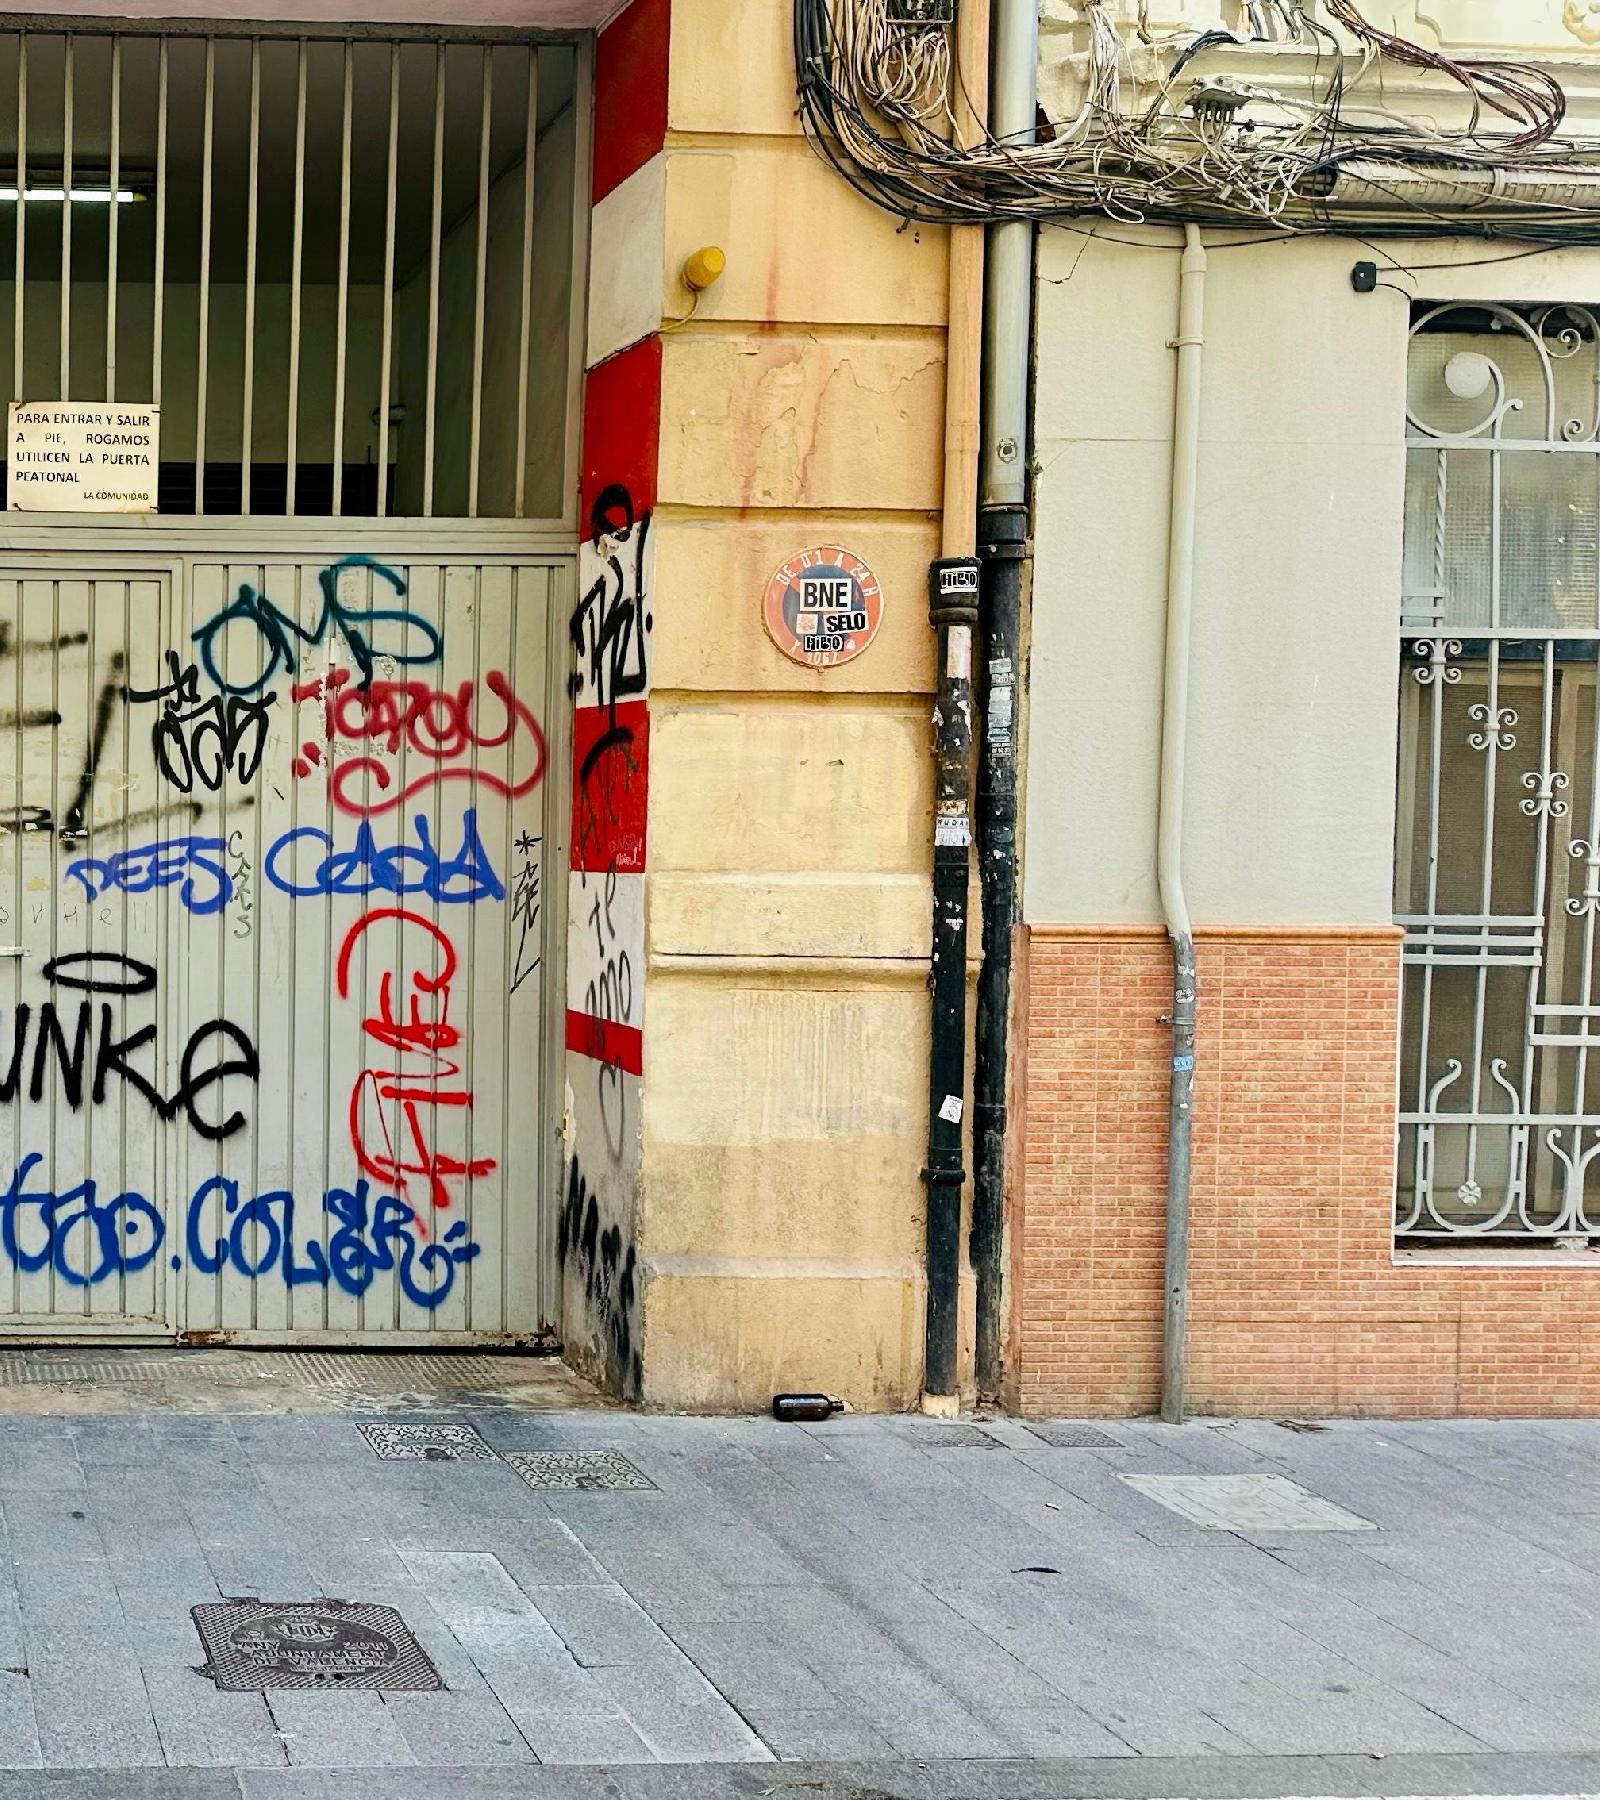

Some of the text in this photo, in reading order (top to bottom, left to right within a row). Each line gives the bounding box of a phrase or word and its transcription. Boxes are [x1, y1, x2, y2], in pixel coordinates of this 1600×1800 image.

[16, 413, 150, 426] PARA ENTRAR Y SALIR
[16, 432, 150, 446] A PIE, ROGAMOS
[16, 451, 150, 466] UTILICEN LA PUERTA
[16, 471, 80, 483] PEATONAL
[83, 491, 149, 501] LA COMUNIDAD
[833, 552, 844, 567] A
[803, 582, 848, 608] BNE
[826, 613, 866, 633] SELO
